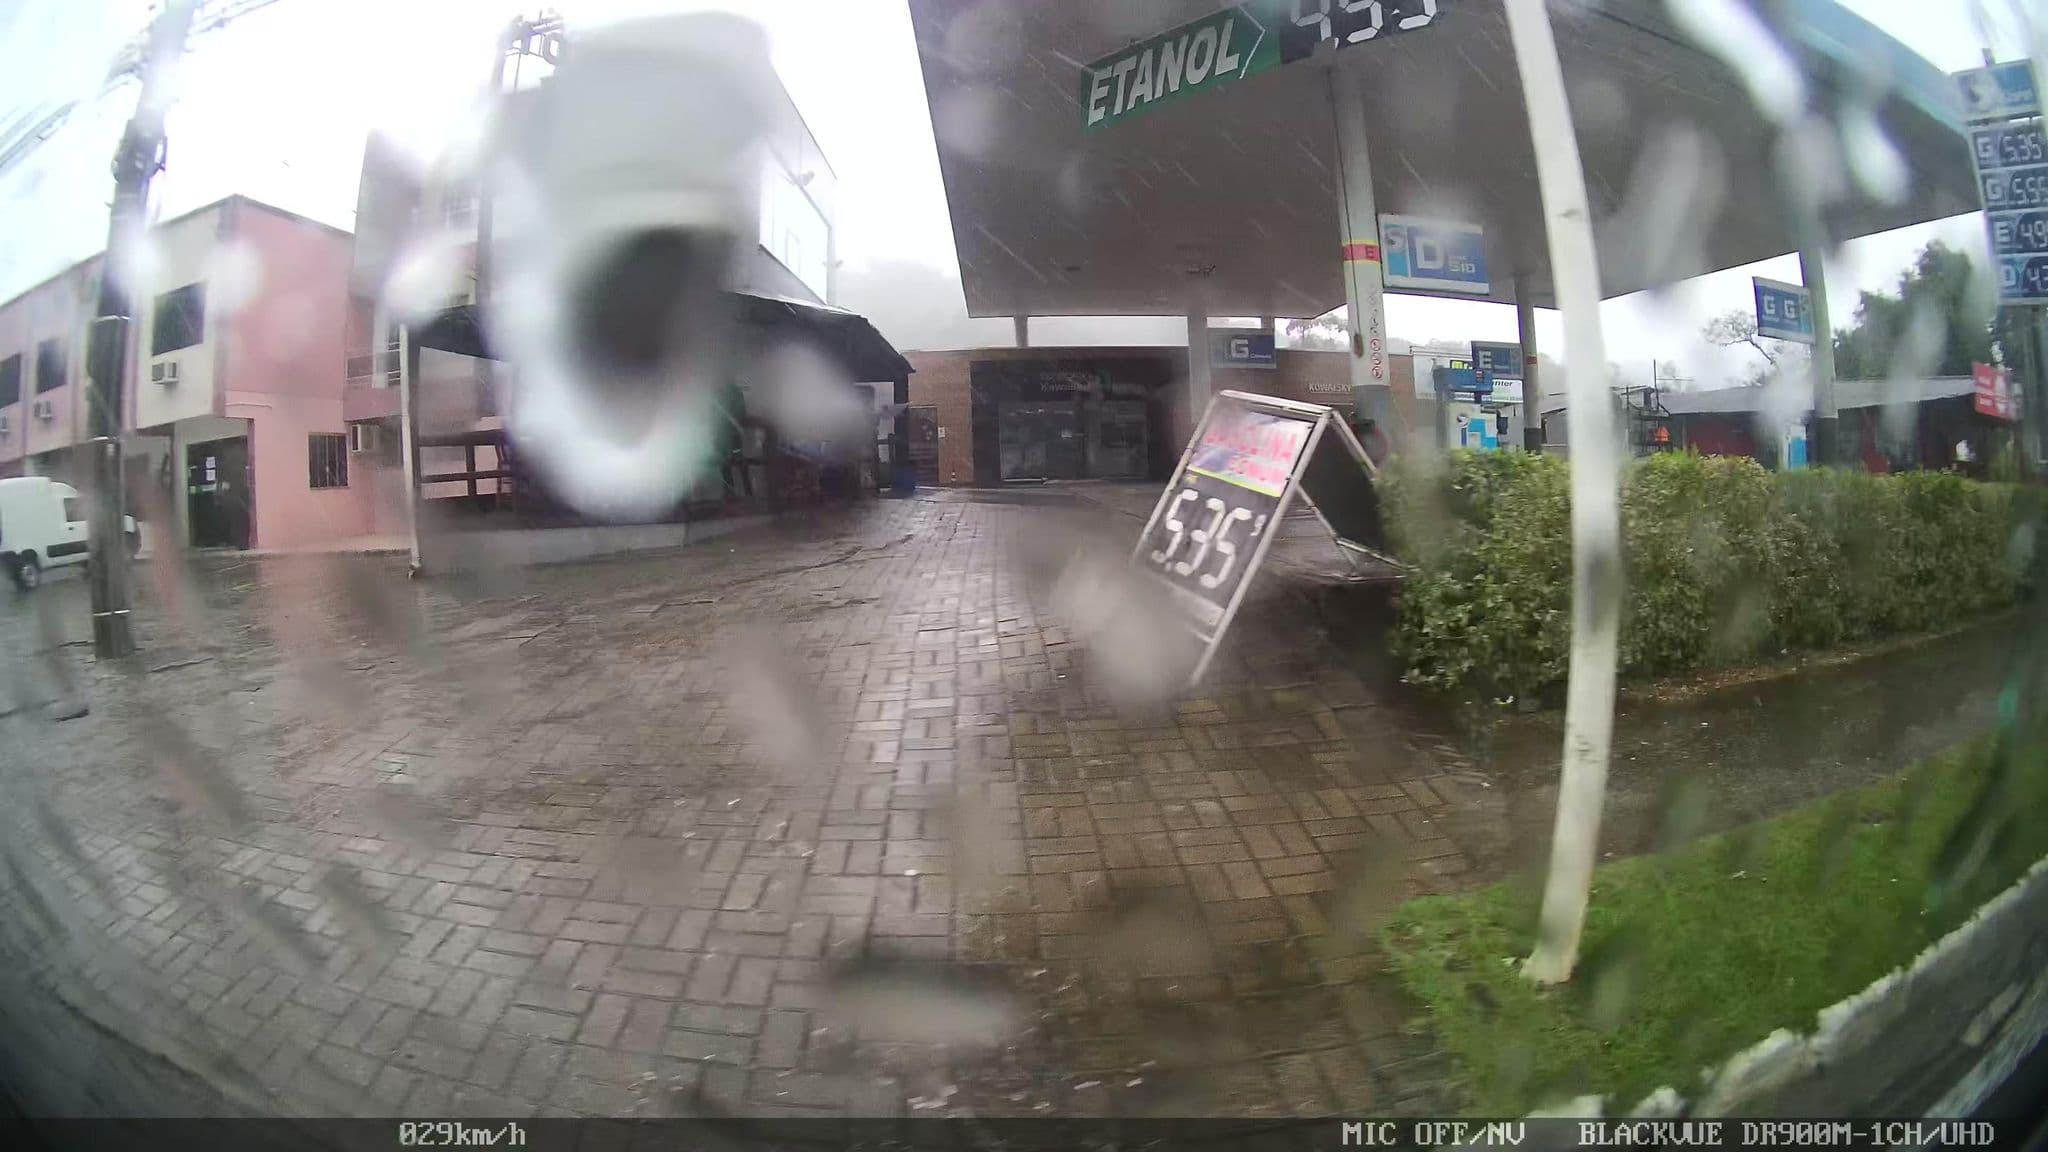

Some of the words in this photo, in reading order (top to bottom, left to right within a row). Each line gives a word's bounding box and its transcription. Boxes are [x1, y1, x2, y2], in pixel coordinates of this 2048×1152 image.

[1087, 18, 1240, 127] ETANOL
[1994, 221, 2011, 243] E
[1415, 236, 1444, 269] D
[1231, 339, 1249, 358] G
[1479, 351, 1491, 370] E
